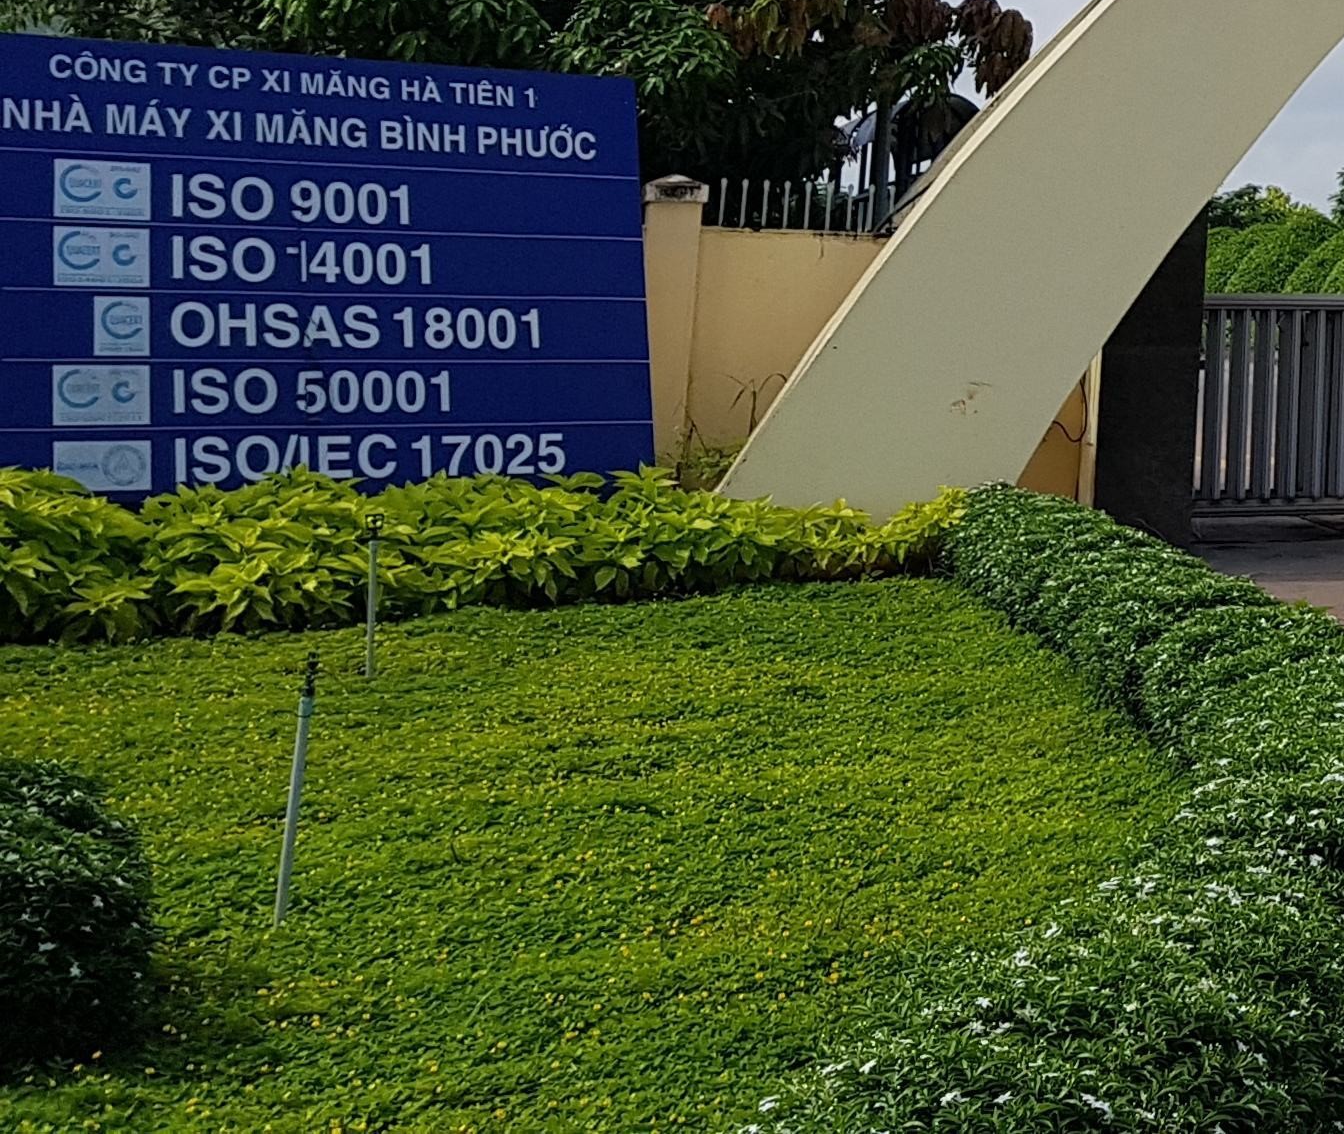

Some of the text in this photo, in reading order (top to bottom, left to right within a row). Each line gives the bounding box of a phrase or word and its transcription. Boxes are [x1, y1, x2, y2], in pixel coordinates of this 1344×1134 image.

[49, 51, 537, 108] CÔNG TY CP XI MĂNG HÀ TIÊN 1
[2, 94, 597, 161] NHÀ MÁY XI MĂNG BÌNH PHƯỚC
[171, 173, 410, 225] ISO 9001
[171, 235, 276, 283] ISO
[170, 301, 541, 349] OHSAS 18001
[172, 368, 451, 414] ISO 50001
[174, 433, 566, 482] ISO/IEC 17025
